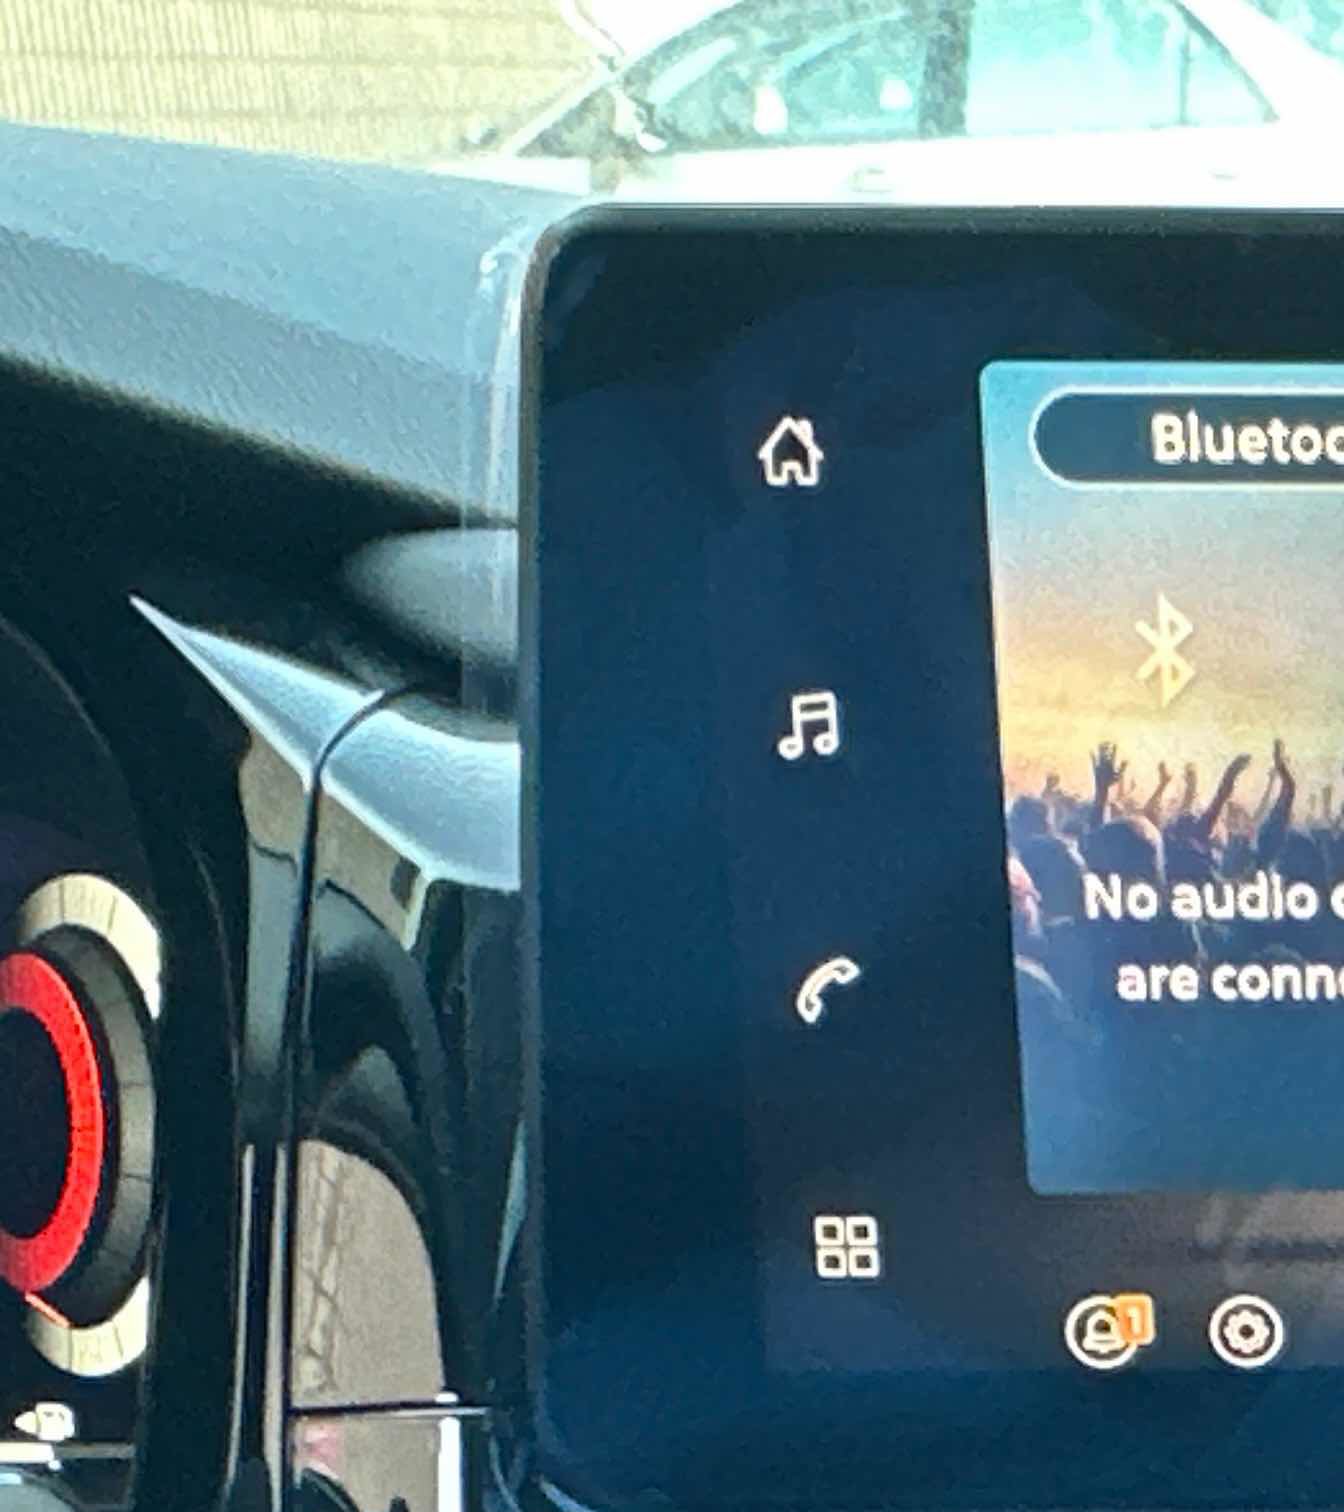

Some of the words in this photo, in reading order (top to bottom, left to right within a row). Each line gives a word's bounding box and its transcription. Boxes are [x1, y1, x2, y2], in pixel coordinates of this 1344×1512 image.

[1083, 875, 1157, 919] No
[1171, 871, 1318, 920] audio
[1117, 961, 1199, 1000] are
